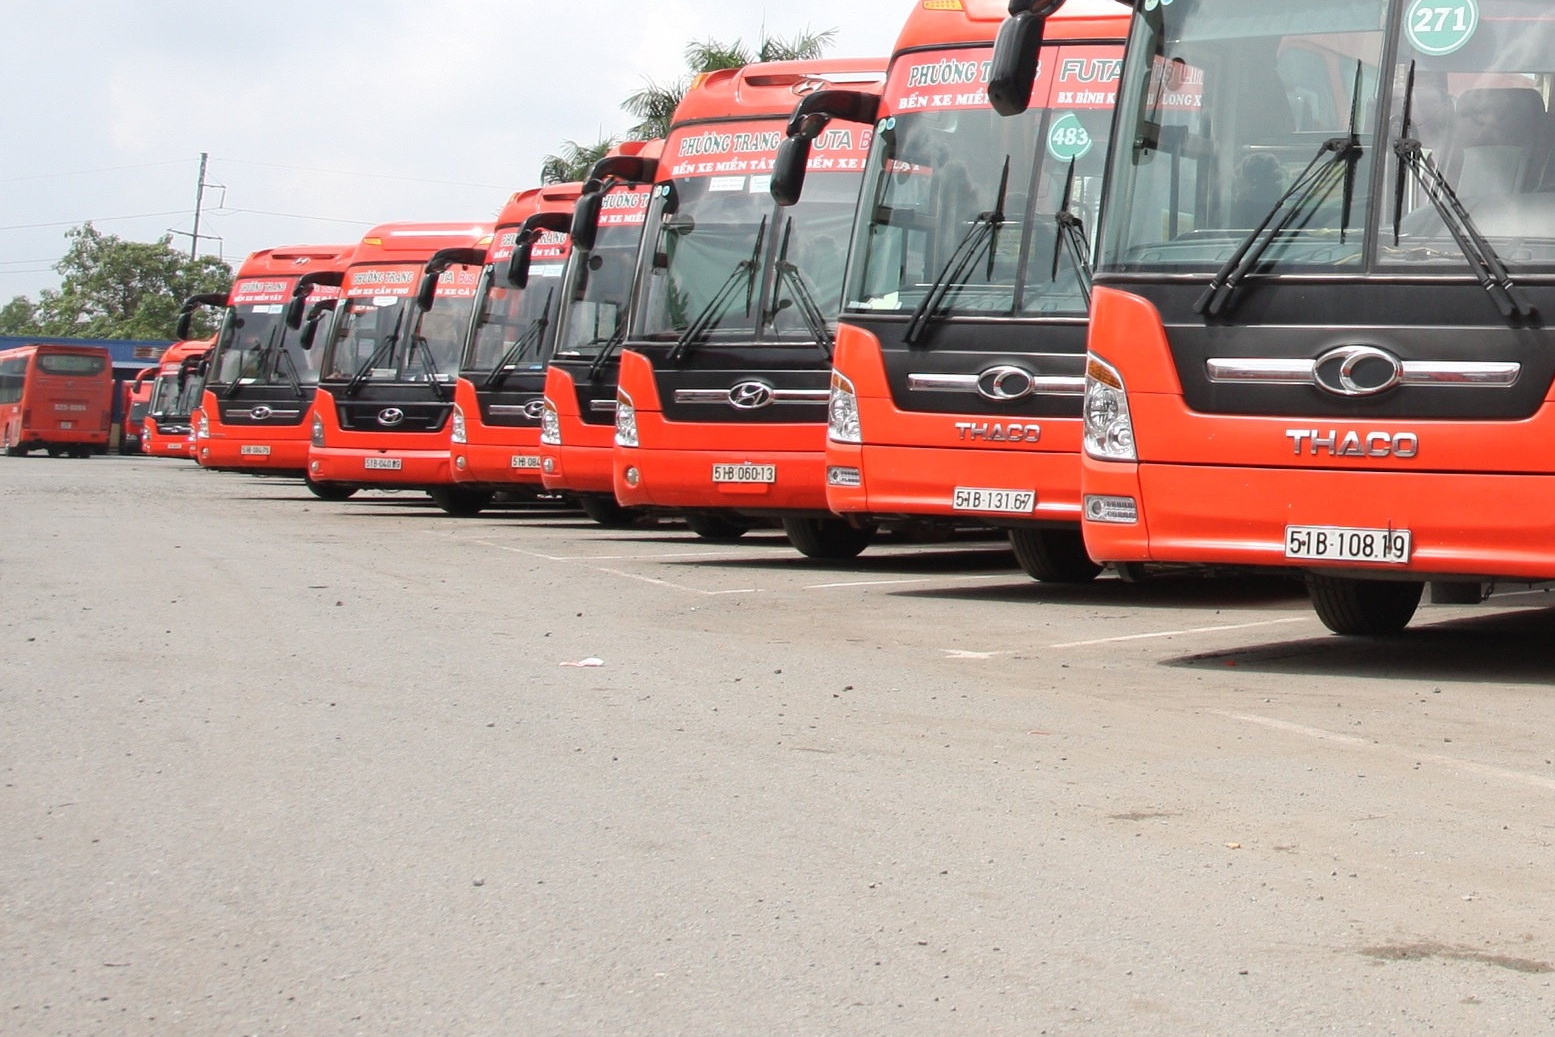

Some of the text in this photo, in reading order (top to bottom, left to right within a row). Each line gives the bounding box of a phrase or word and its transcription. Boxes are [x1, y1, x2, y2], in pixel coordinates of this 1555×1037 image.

[1413, 6, 1467, 32] 271
[907, 58, 977, 88] PHƯƠNG
[898, 87, 991, 109] BẾN XE MIỀ
[1057, 92, 1074, 103] BX
[1075, 88, 1105, 104] BÌNH
[1163, 94, 1192, 105] LONG
[678, 130, 780, 157] PHƯƠNG TRANG
[814, 130, 852, 150] UTA
[1052, 128, 1089, 145] 483
[672, 156, 775, 176] BẾN XE MIỀN TÂY
[807, 156, 834, 169] BẾN
[837, 158, 860, 169] XE
[600, 192, 638, 210] HƯƠNG
[608, 214, 623, 223] XE
[541, 231, 567, 245] RANG
[955, 422, 1040, 442] THACO
[1285, 429, 1418, 458] THACO
[1290, 530, 1405, 559] 51B-108.19
